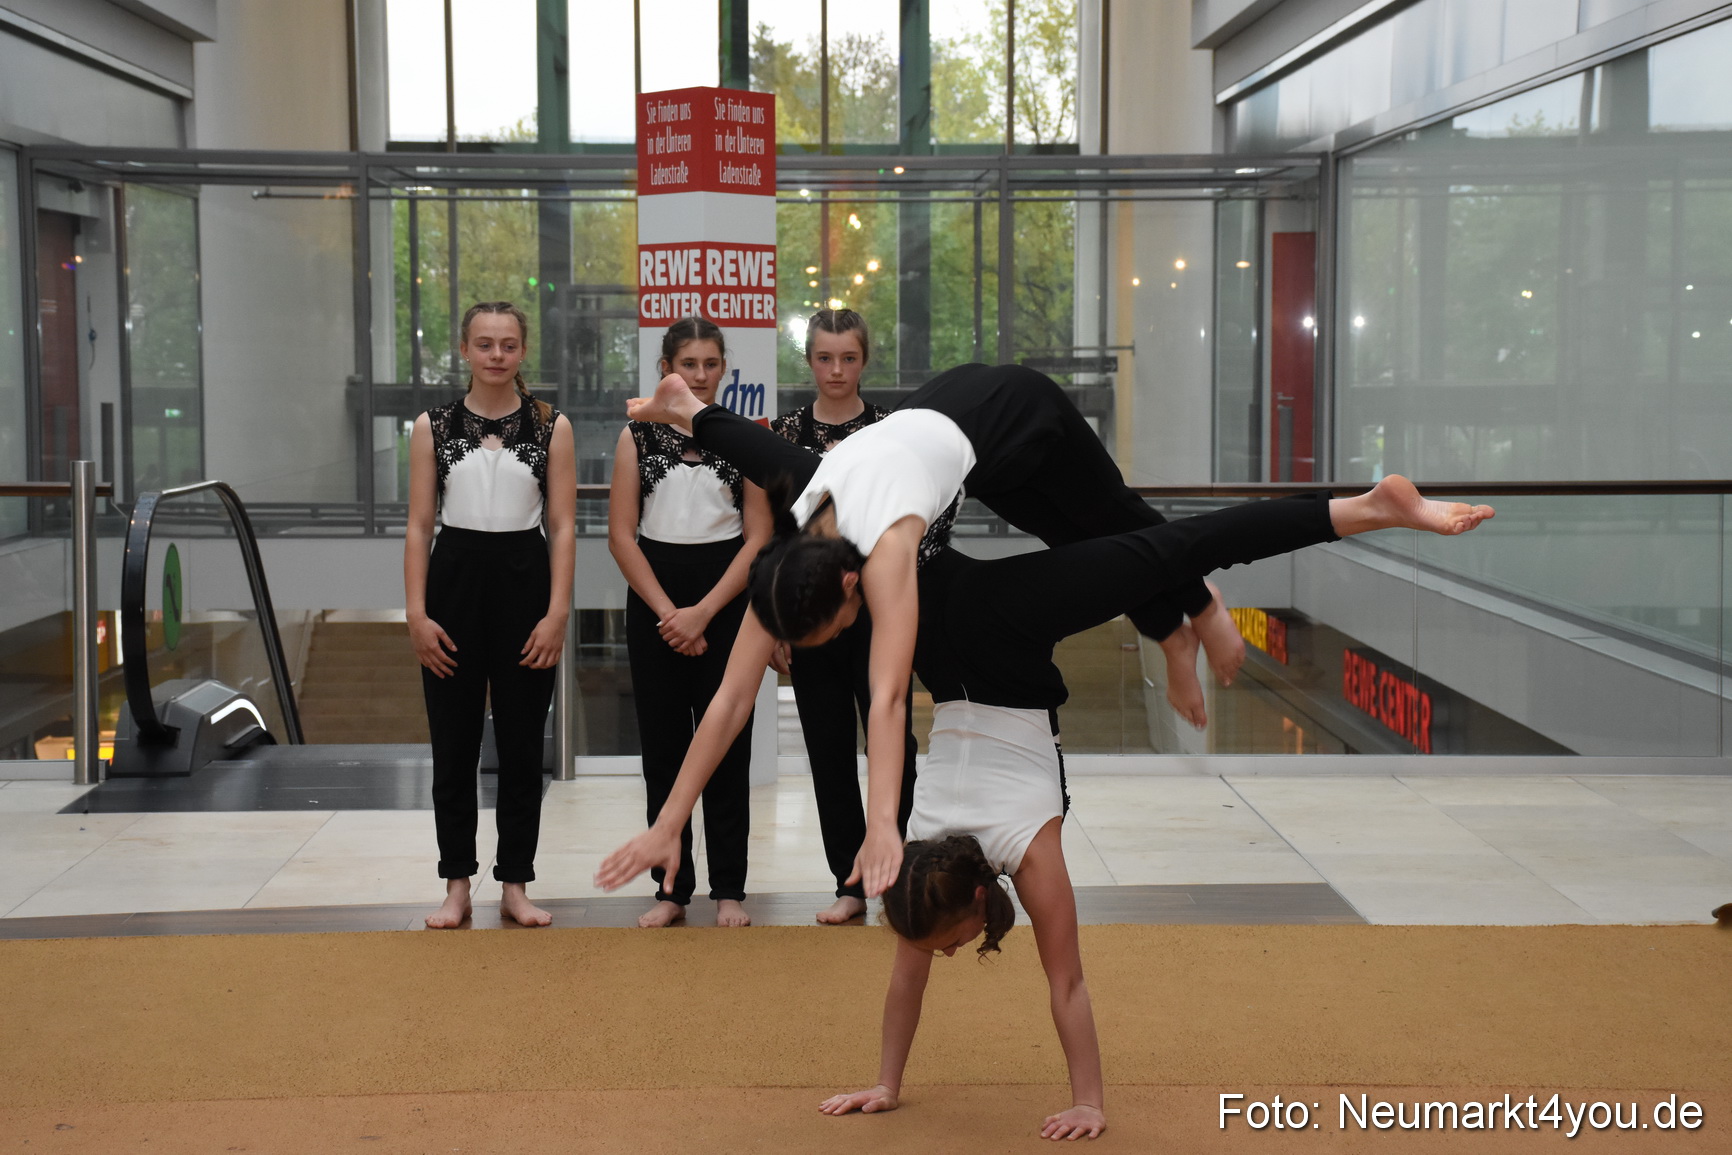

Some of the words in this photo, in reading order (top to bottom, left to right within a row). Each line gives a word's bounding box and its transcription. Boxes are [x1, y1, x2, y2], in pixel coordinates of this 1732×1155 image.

[646, 101, 657, 124] Sie
[680, 102, 691, 121] uns
[714, 96, 726, 120] Sie
[752, 106, 765, 124] uns
[647, 133, 654, 155] in
[655, 131, 665, 154] der
[666, 125, 691, 153] Unteren
[715, 129, 722, 151] in
[724, 129, 736, 152] der
[736, 126, 765, 155] Unteren
[650, 160, 689, 186] Ladenstraße
[719, 160, 761, 186] Ladenstraße
[639, 249, 702, 287] REWE
[706, 249, 775, 287] REWE
[640, 292, 702, 319] CENTER
[706, 292, 775, 320] CENTER
[721, 369, 765, 417] dm
[1343, 648, 1377, 719] REWE
[1380, 671, 1431, 754] CENTER
